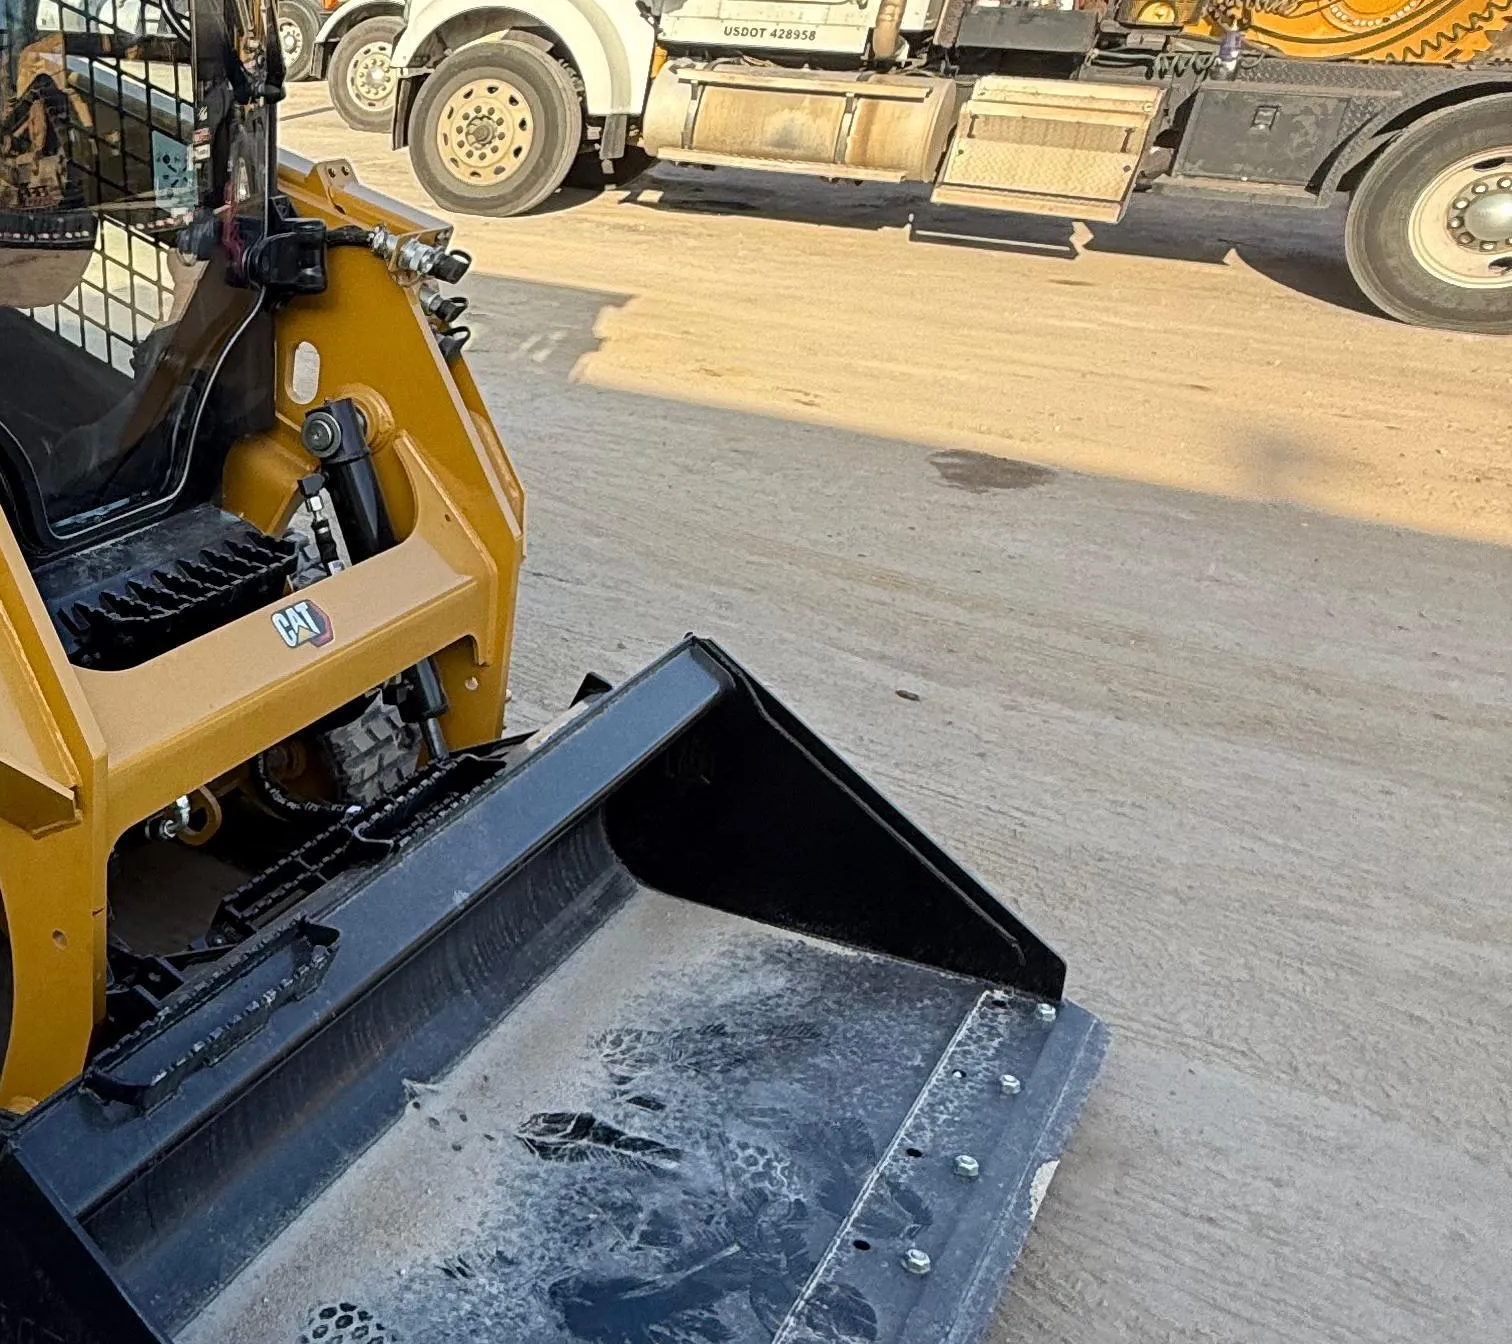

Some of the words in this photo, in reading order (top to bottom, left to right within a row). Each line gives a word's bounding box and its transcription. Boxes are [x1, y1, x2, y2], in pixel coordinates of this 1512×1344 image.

[724, 25, 767, 38] USDOT
[770, 28, 816, 41] 428958
[271, 601, 321, 647] CAT
